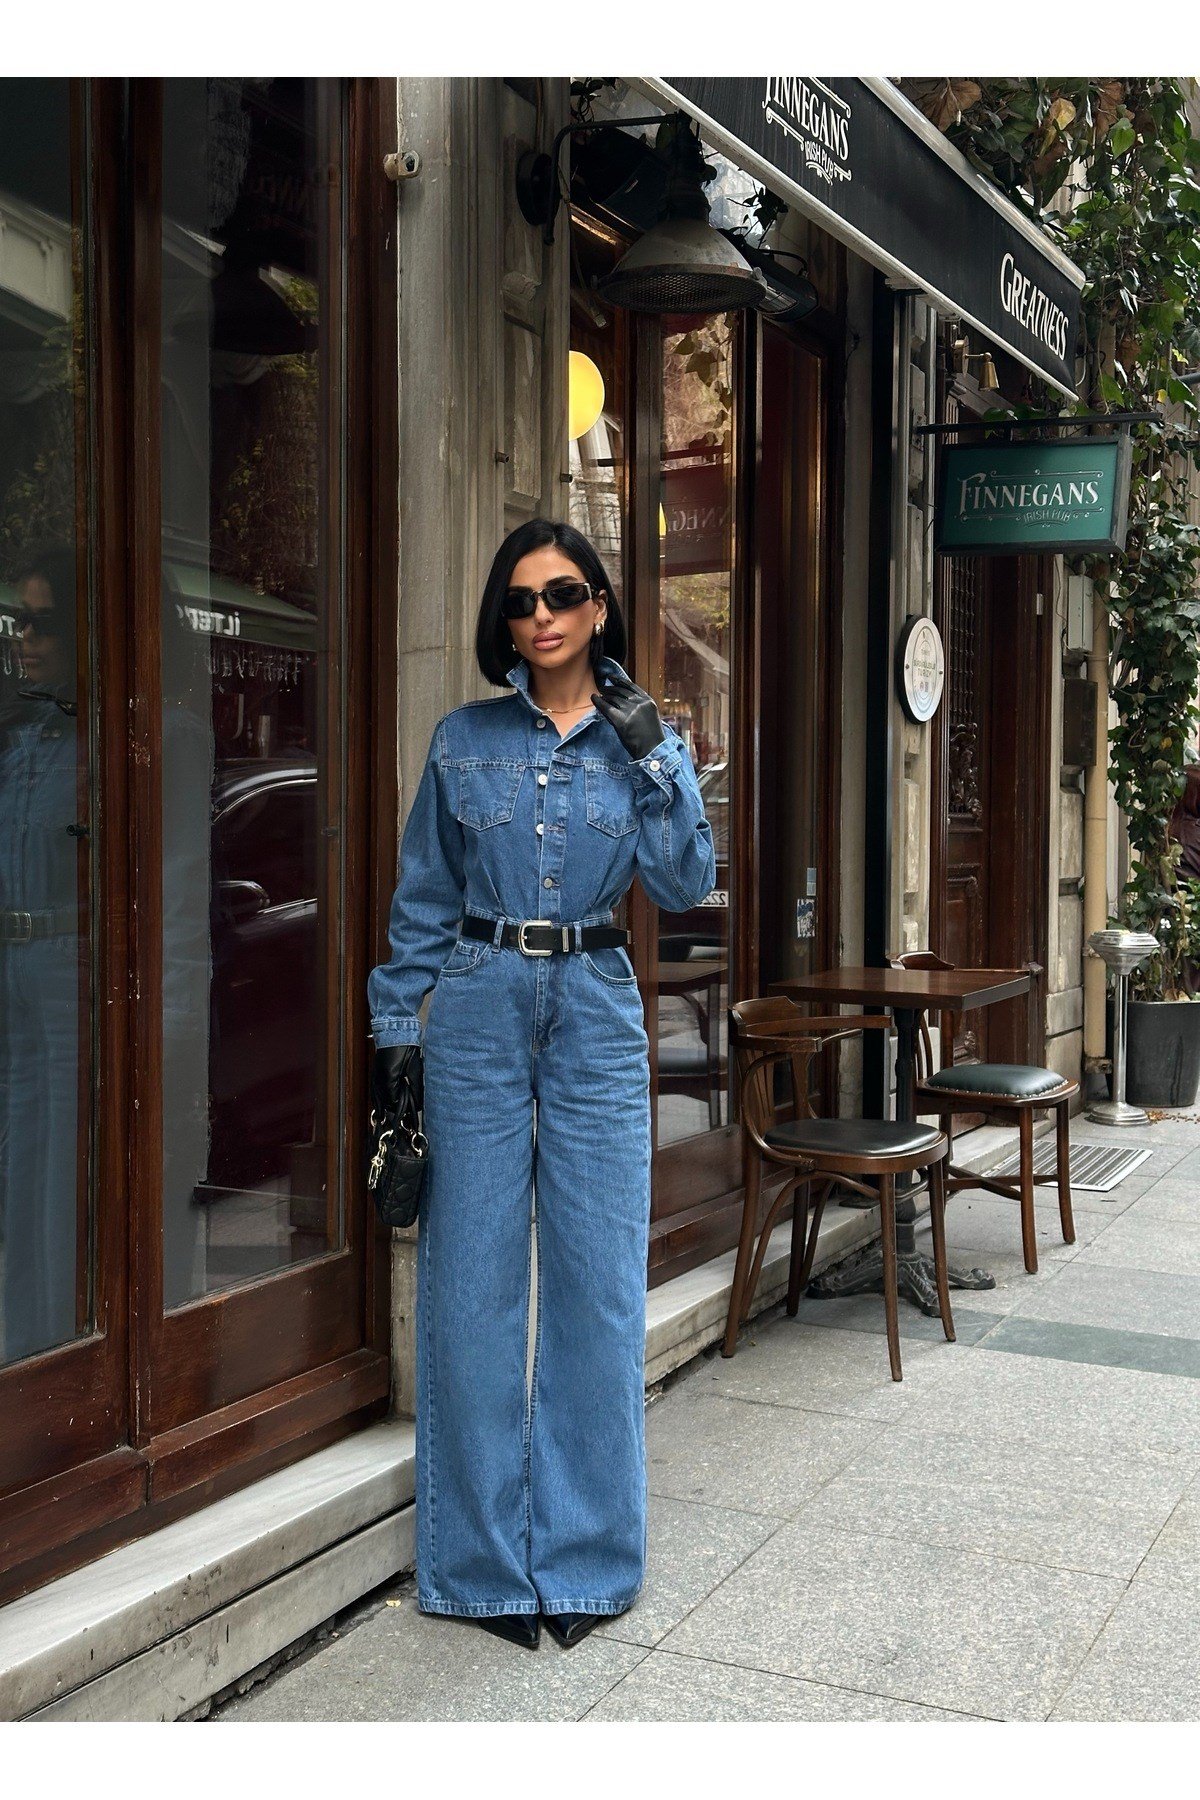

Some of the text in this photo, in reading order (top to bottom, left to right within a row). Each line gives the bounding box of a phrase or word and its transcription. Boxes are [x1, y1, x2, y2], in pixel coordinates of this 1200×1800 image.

[804, 141, 834, 179] IRISH PUB
[1000, 252, 1069, 361] GREATNESS
[958, 472, 1100, 515] FINNEGANS
[1023, 510, 1071, 522] IRISH PUB
